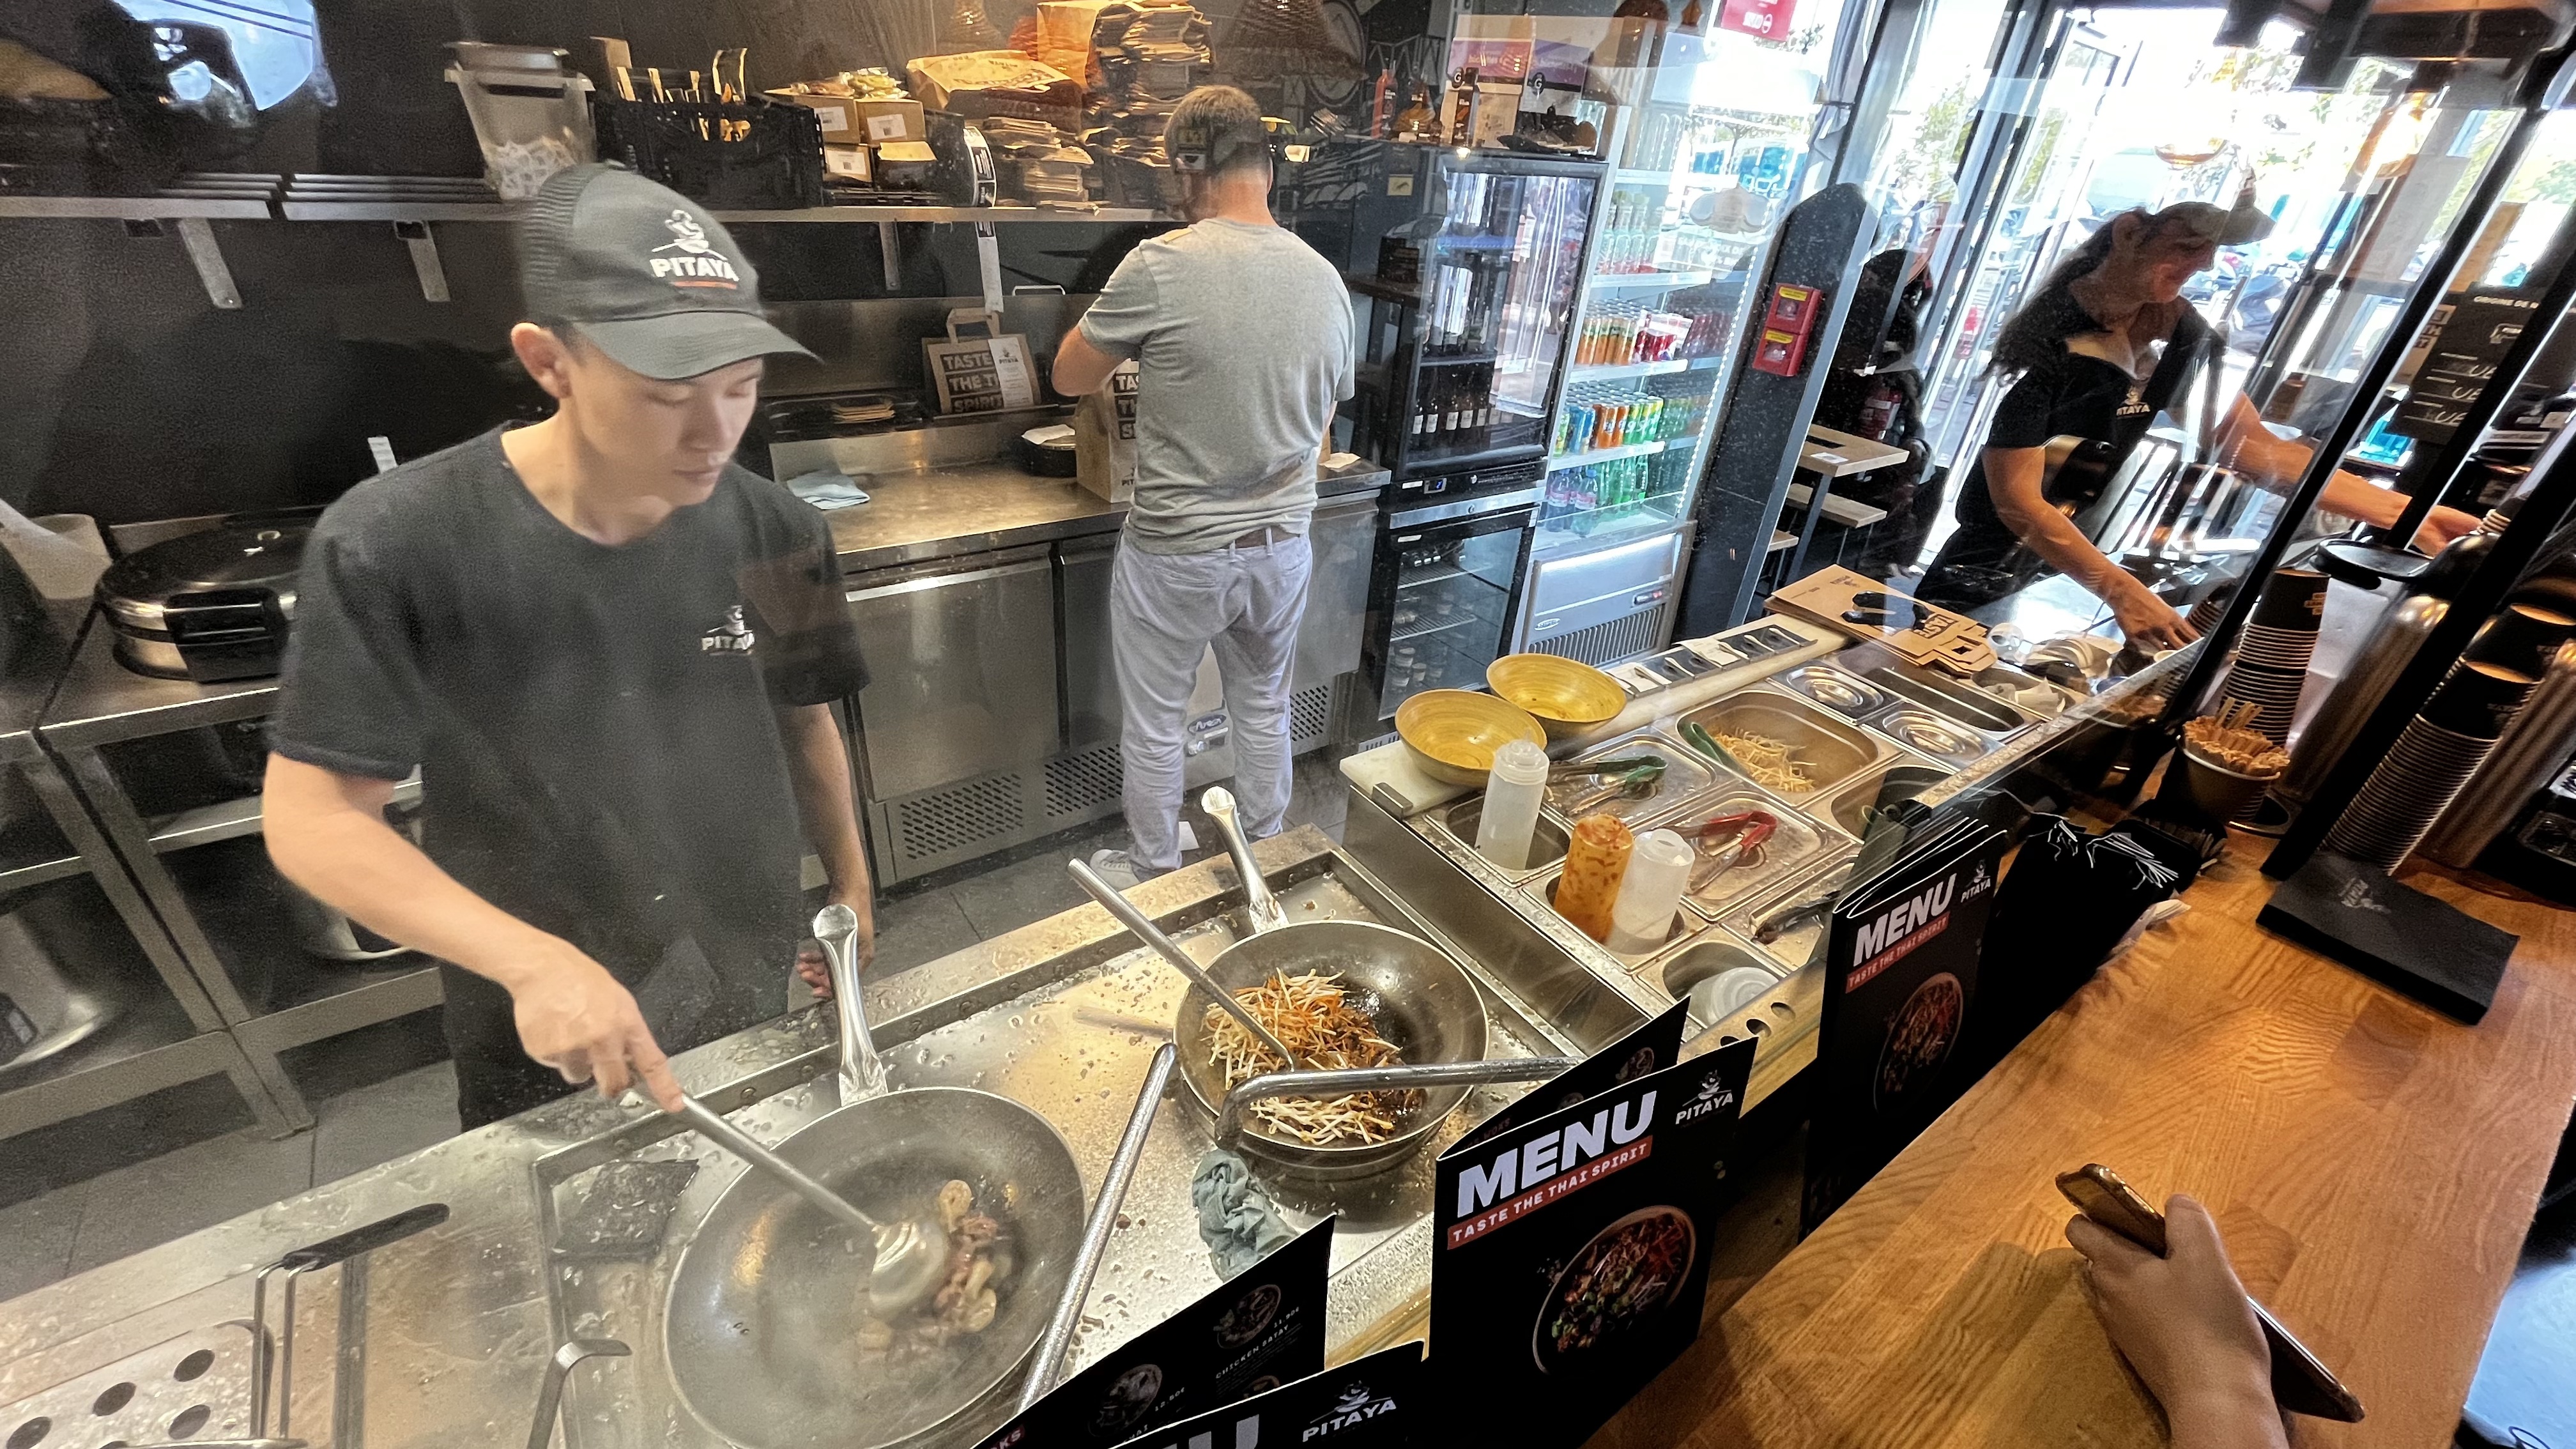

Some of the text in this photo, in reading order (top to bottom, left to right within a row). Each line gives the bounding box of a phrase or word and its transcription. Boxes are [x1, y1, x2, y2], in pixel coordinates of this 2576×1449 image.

[650, 257, 740, 282] PITAYA
[943, 352, 994, 371] TASTE
[949, 374, 982, 392] THE
[1853, 873, 1991, 967] MENU PITAYA
[1849, 917, 1947, 987] TASTE THE THAI SPIRIT
[1457, 1091, 1733, 1218] MENU PITAYA
[1453, 1144, 1647, 1242] TASTE THE THAI SPIRIT
[1216, 1324, 1289, 1379] CHICKEN SATAY
[1303, 1399, 1397, 1443] PITAYA
